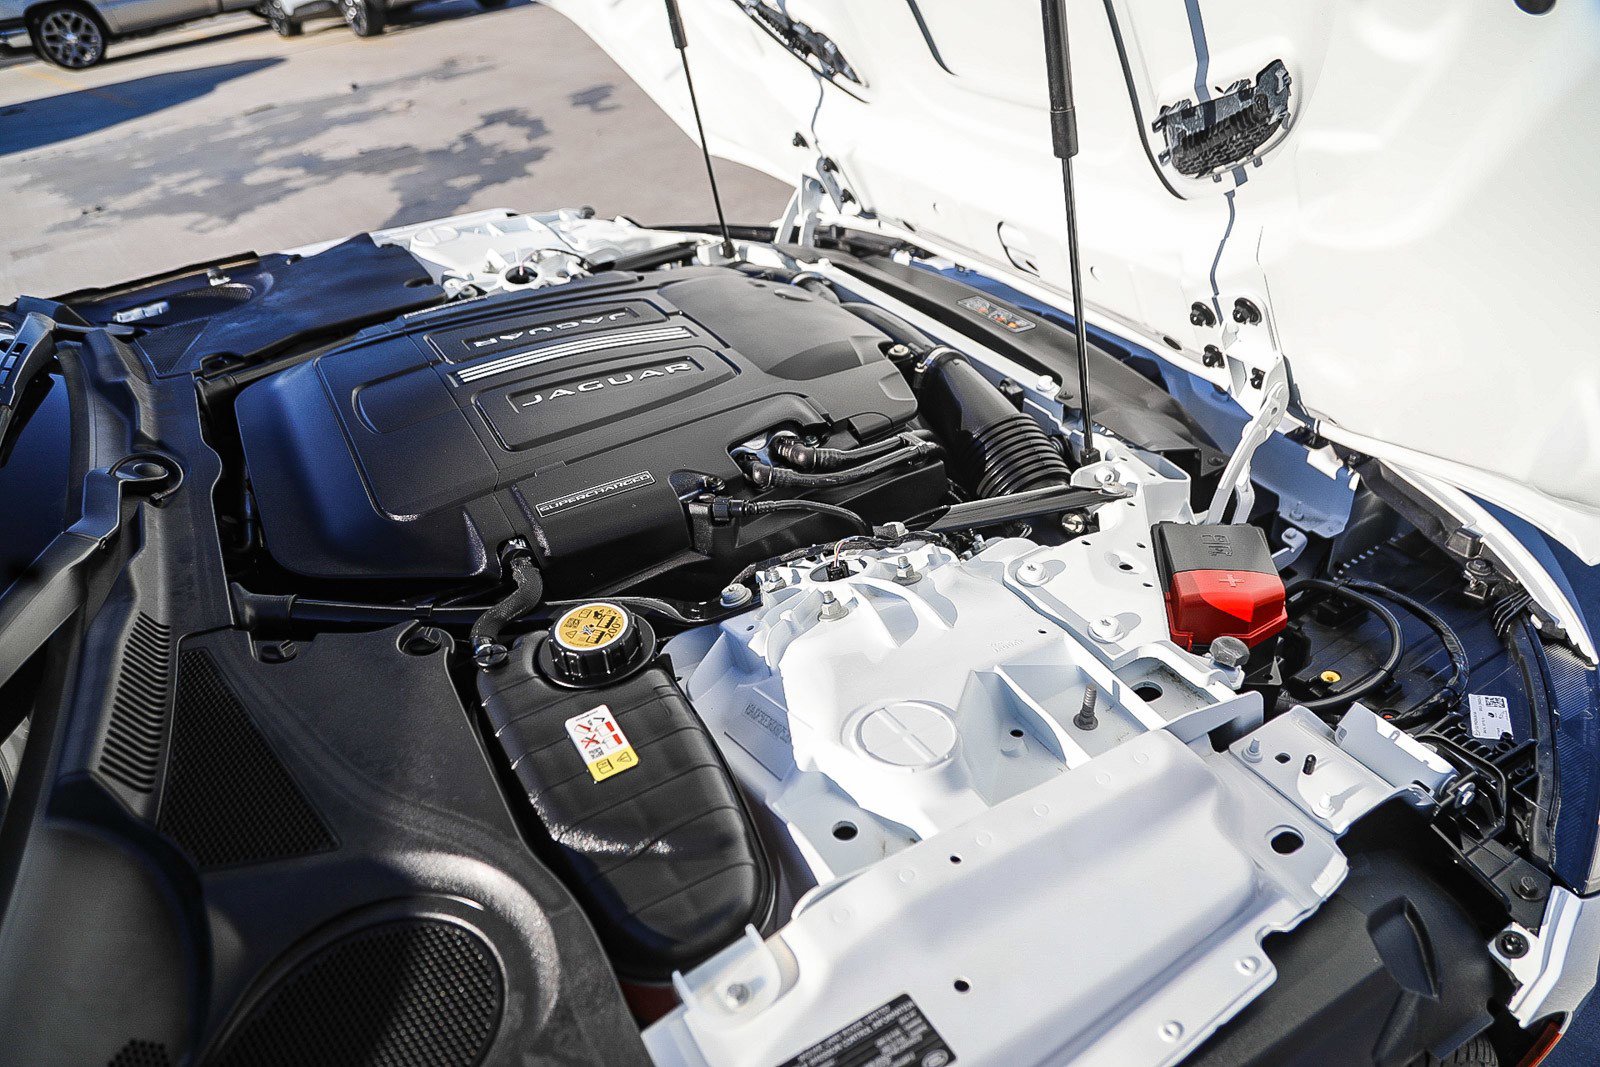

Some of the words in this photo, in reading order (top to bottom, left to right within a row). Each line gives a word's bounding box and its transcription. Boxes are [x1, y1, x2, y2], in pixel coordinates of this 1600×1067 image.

[473, 312, 626, 348] JAGUAR
[522, 363, 692, 407] JAGUAR
[539, 474, 650, 512] SUPERCHARGED
[604, 623, 621, 639] 200
